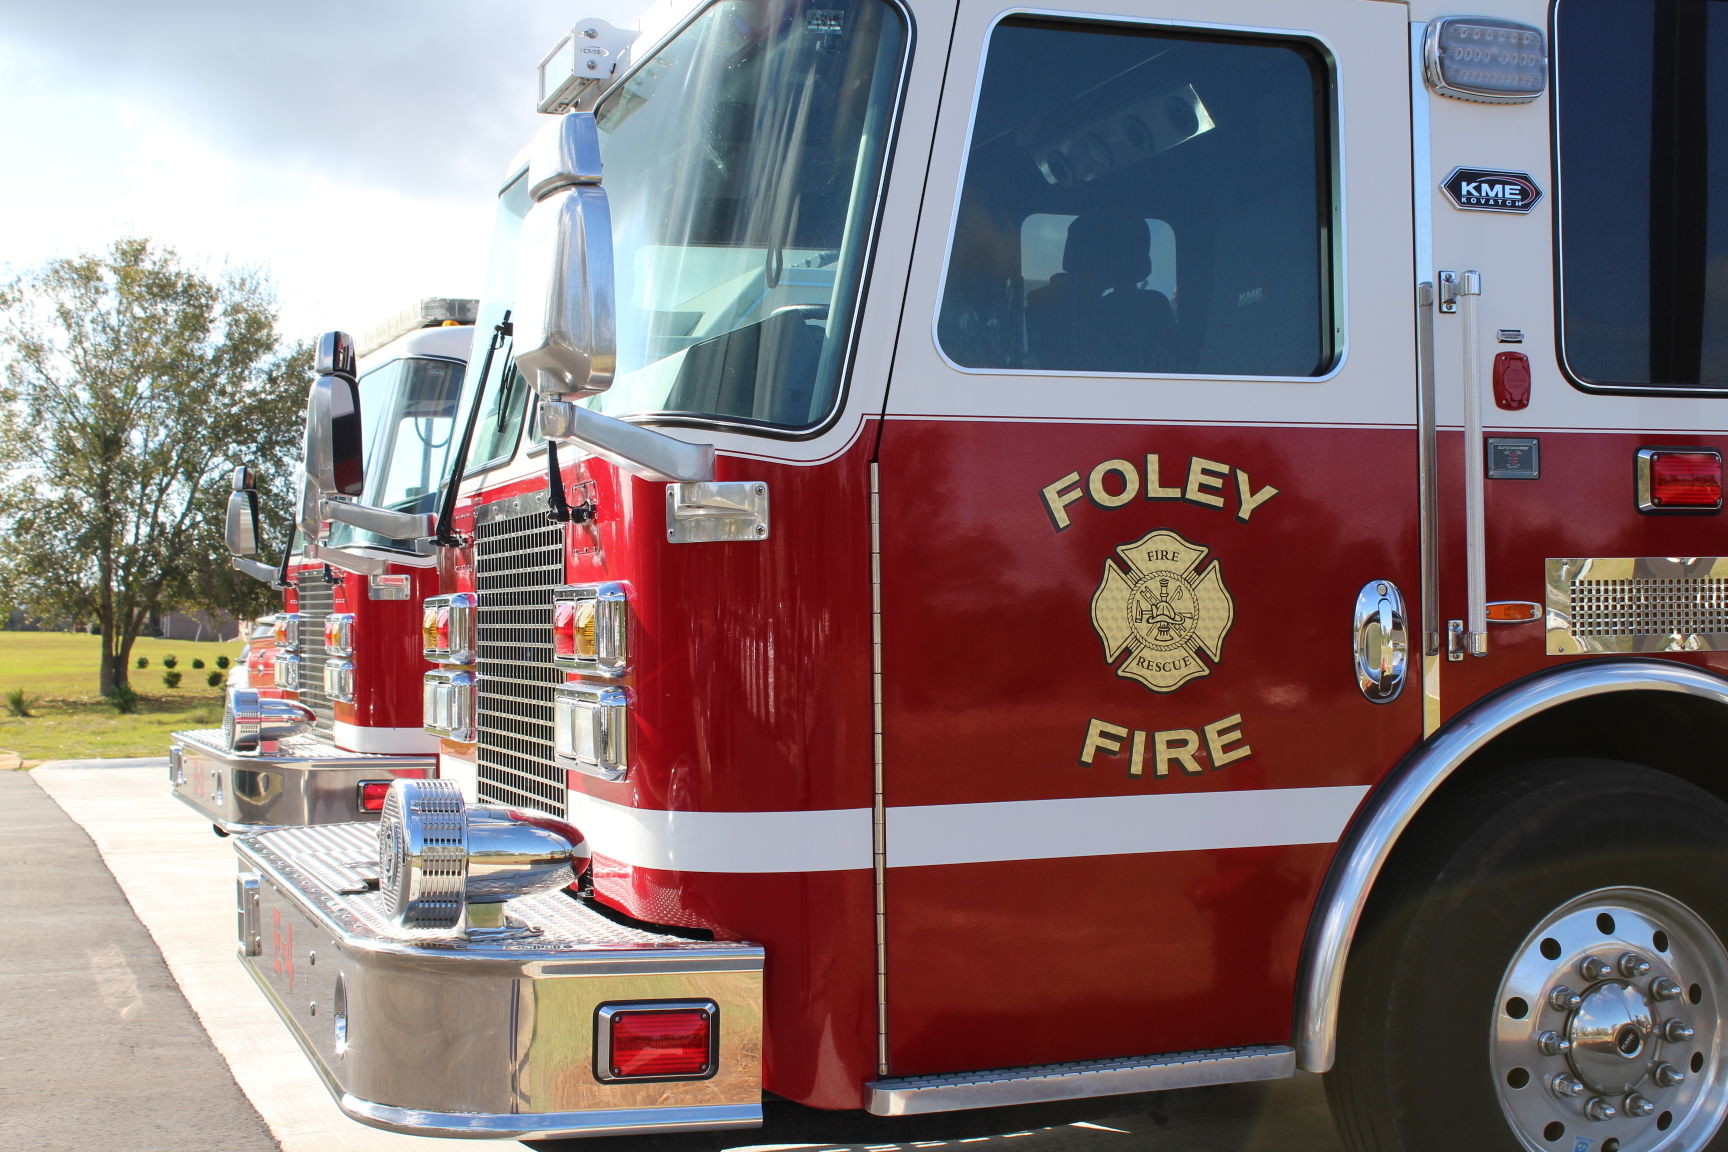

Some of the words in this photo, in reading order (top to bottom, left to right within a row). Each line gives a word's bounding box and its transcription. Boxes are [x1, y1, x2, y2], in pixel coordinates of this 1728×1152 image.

[1461, 182, 1521, 198] KME
[1461, 197, 1522, 206] KOVATCH
[1040, 454, 1280, 532] FOLEY
[1147, 550, 1180, 562] FIRE
[1137, 656, 1192, 672] RESCUE
[1078, 713, 1252, 779] FIRE
